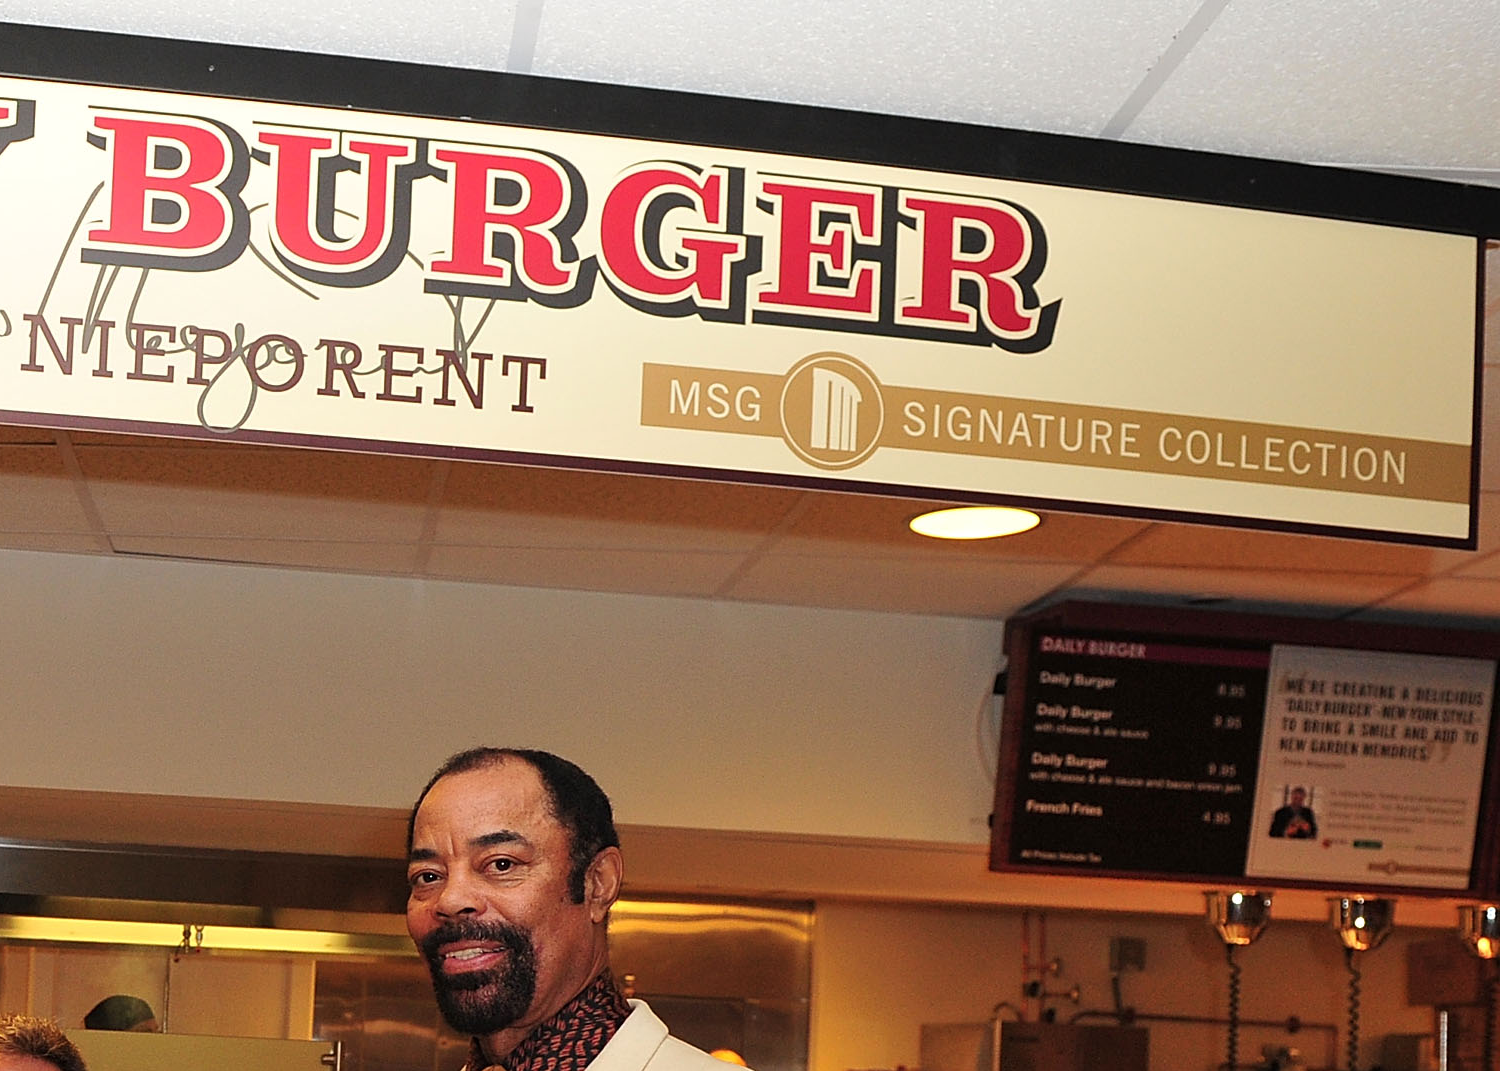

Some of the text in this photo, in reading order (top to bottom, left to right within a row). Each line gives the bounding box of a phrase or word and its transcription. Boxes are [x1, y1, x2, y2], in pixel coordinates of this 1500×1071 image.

[81, 105, 1061, 355] BURGER
[21, 313, 547, 413] NIEPORENT
[669, 378, 1406, 485] MSG SIGNATURE COLLECTION
[1041, 636, 1147, 659] DAILY BURGER
[1040, 670, 1071, 687] Daily
[1074, 673, 1117, 690] Burger
[1036, 702, 1069, 719] Daily
[1070, 705, 1113, 723] Burger
[1031, 751, 1063, 768] Daily
[1065, 754, 1108, 771] Burger
[1026, 799, 1070, 815] French
[1071, 802, 1103, 817] Fries
